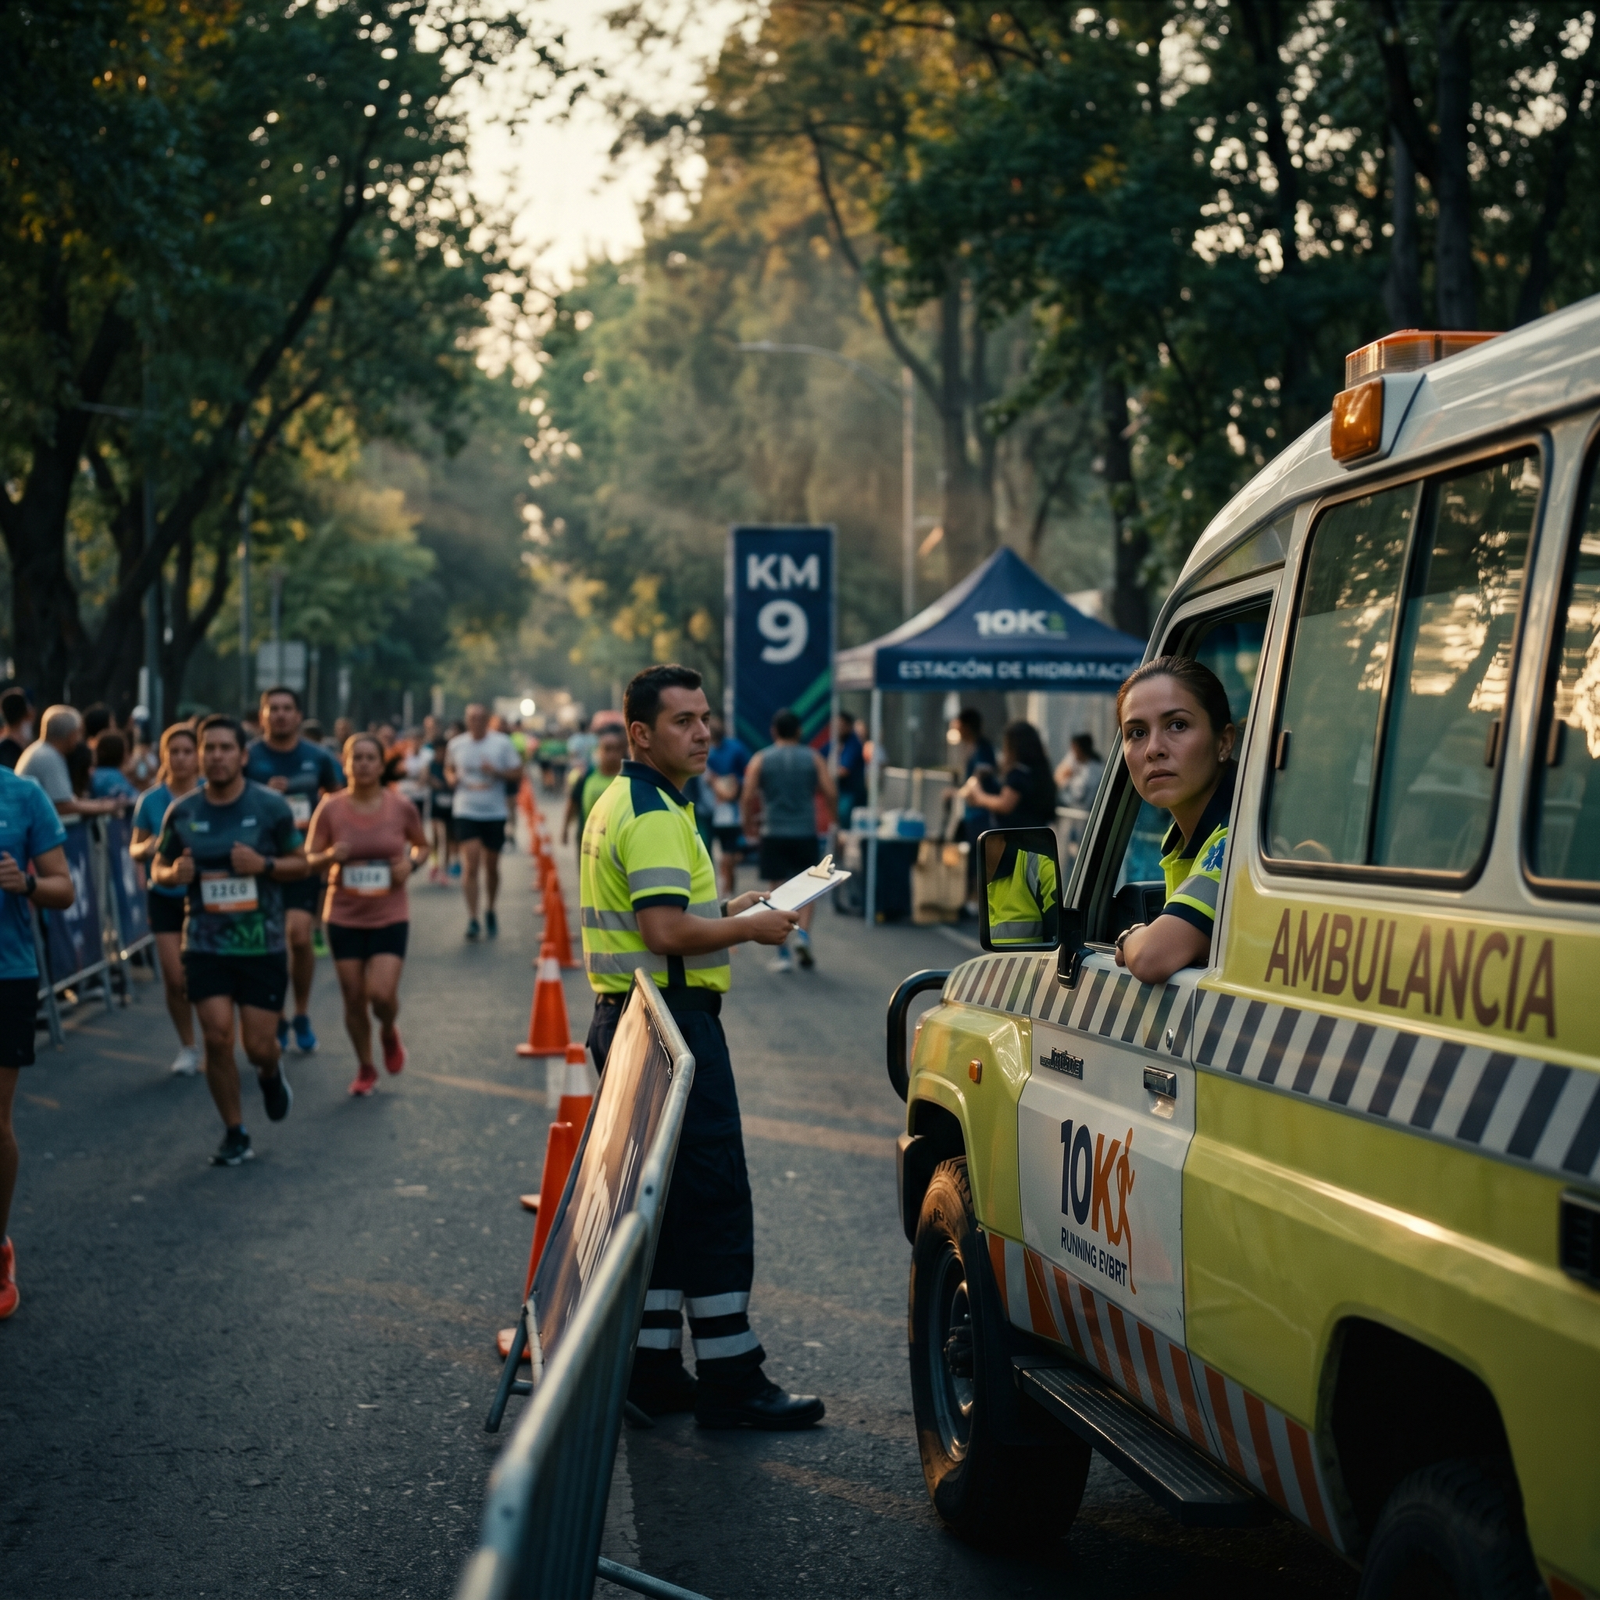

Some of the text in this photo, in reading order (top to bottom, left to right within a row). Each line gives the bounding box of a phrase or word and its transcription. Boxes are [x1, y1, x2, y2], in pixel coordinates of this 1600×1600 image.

[746, 552, 820, 591] KM
[757, 598, 808, 665] 9
[973, 608, 1049, 636] 10K
[898, 657, 995, 679] ESTACIÓN
[997, 660, 1024, 679] DE
[1263, 907, 1557, 1041] AMBULANCIA
[1060, 1118, 1122, 1246] 10K
[1060, 1226, 1097, 1269] RUNNING
